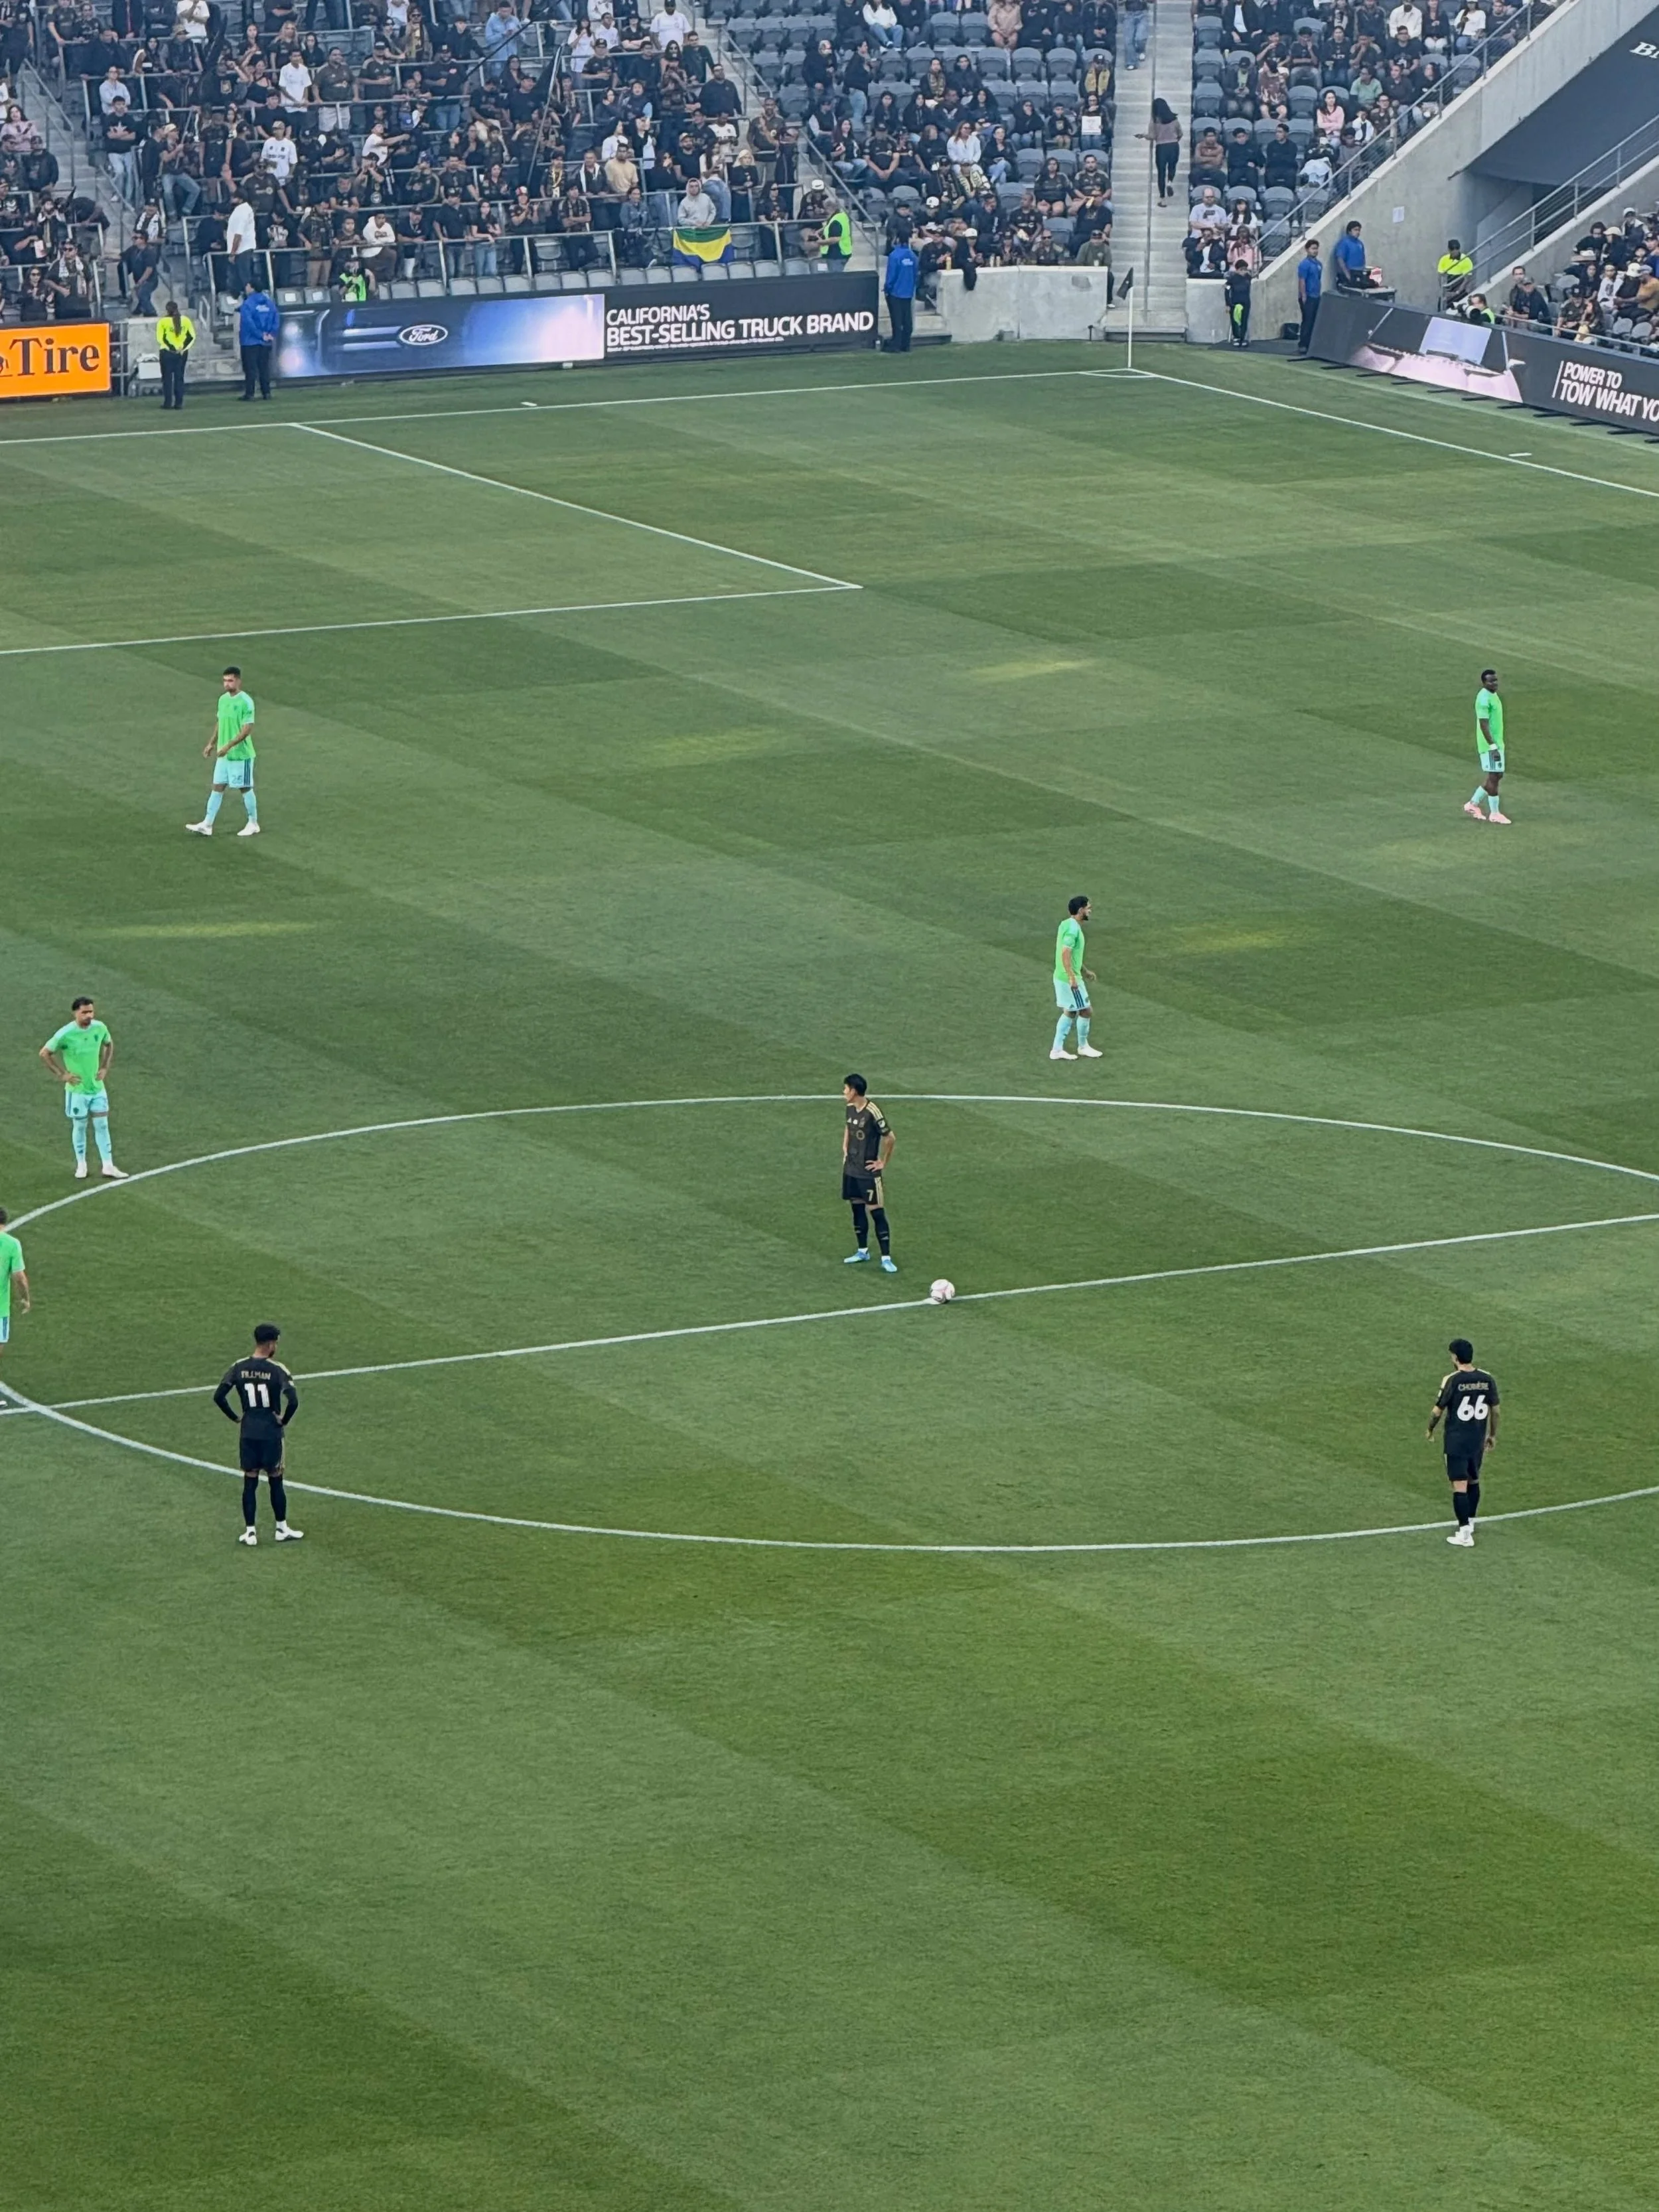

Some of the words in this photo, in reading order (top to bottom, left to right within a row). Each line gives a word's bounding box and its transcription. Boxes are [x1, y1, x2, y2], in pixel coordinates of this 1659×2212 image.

[607, 304, 710, 326] CALIFORNIA'S
[607, 320, 735, 346] BEST-SELLING
[739, 315, 803, 338] TRUCK
[806, 311, 874, 334] BRAND
[409, 327, 439, 342] Ford
[9, 338, 100, 376] Tire
[1563, 362, 1605, 386] POWER
[1606, 370, 1623, 389] TO
[1560, 379, 1596, 407] TOW
[1595, 387, 1642, 417] WHAT
[866, 1189, 874, 1201] 7
[244, 1383, 270, 1408] 11
[1457, 1394, 1488, 1421] 66
